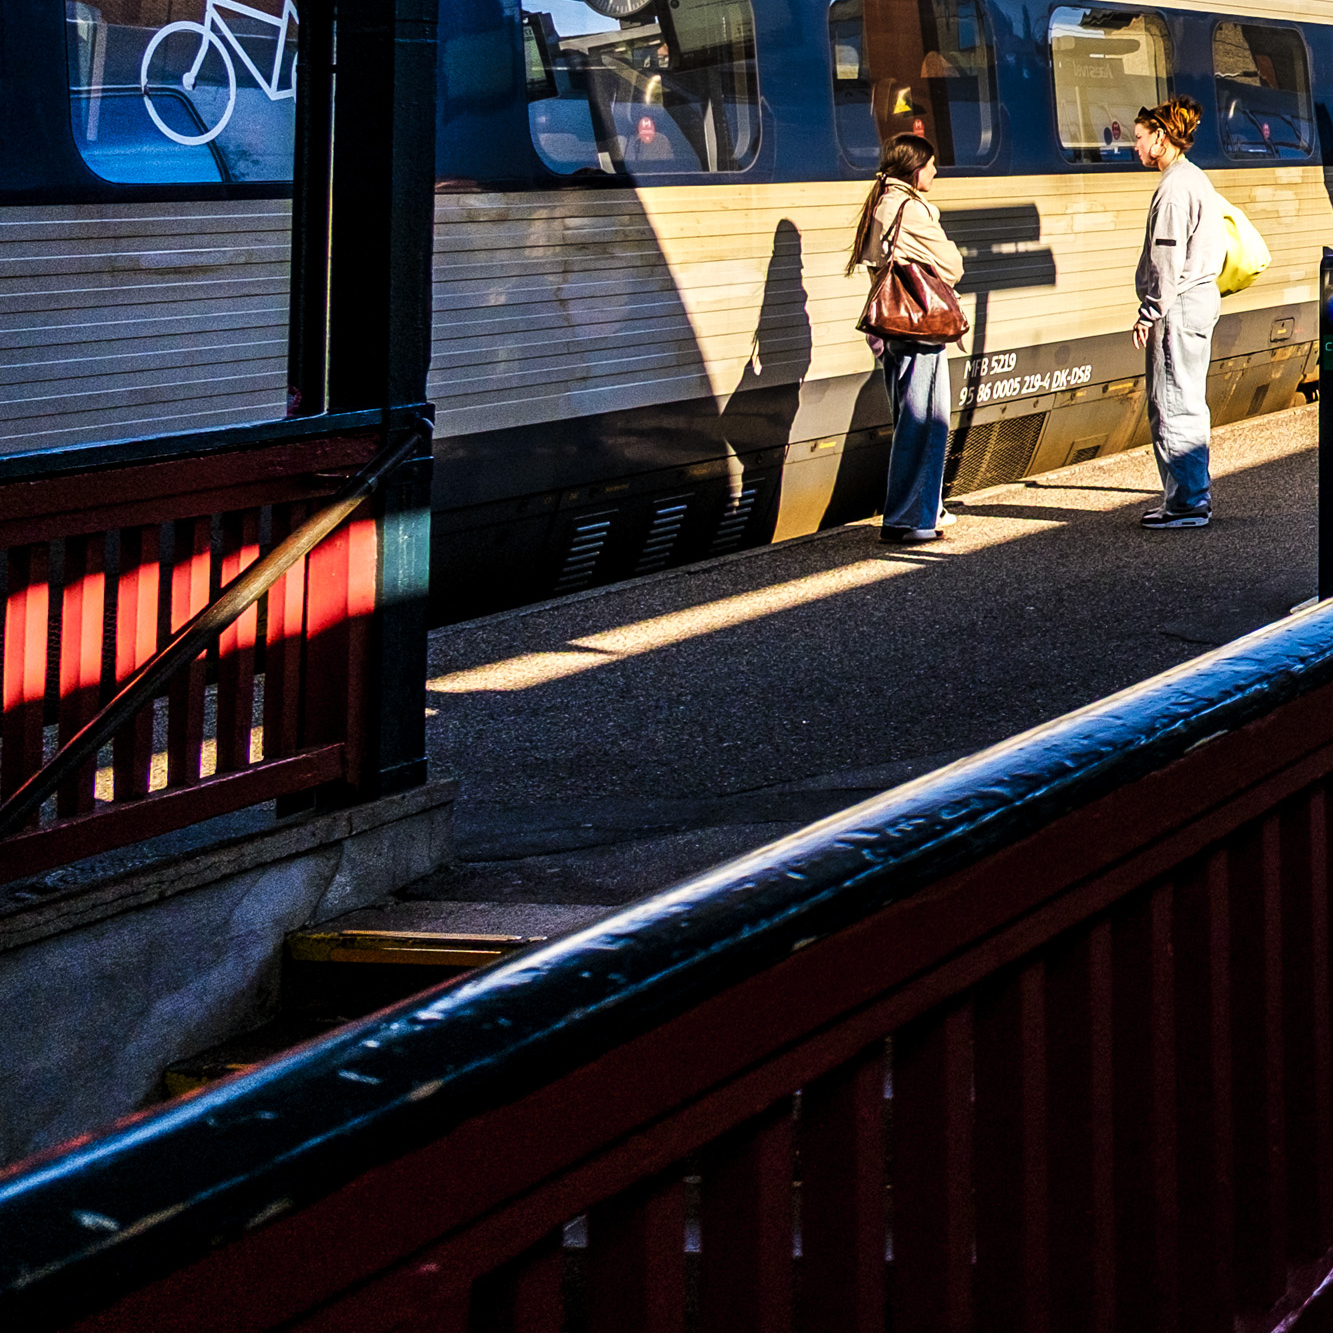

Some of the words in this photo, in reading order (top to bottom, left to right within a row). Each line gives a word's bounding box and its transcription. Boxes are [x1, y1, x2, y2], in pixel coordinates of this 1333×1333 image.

[964, 357, 988, 379] MFB
[990, 352, 1017, 374] 5219
[958, 386, 974, 406] 95
[976, 381, 991, 402] 86
[992, 377, 1021, 398] 0005
[1021, 372, 1051, 394] 219-4
[1051, 364, 1092, 391] DK-DSB
